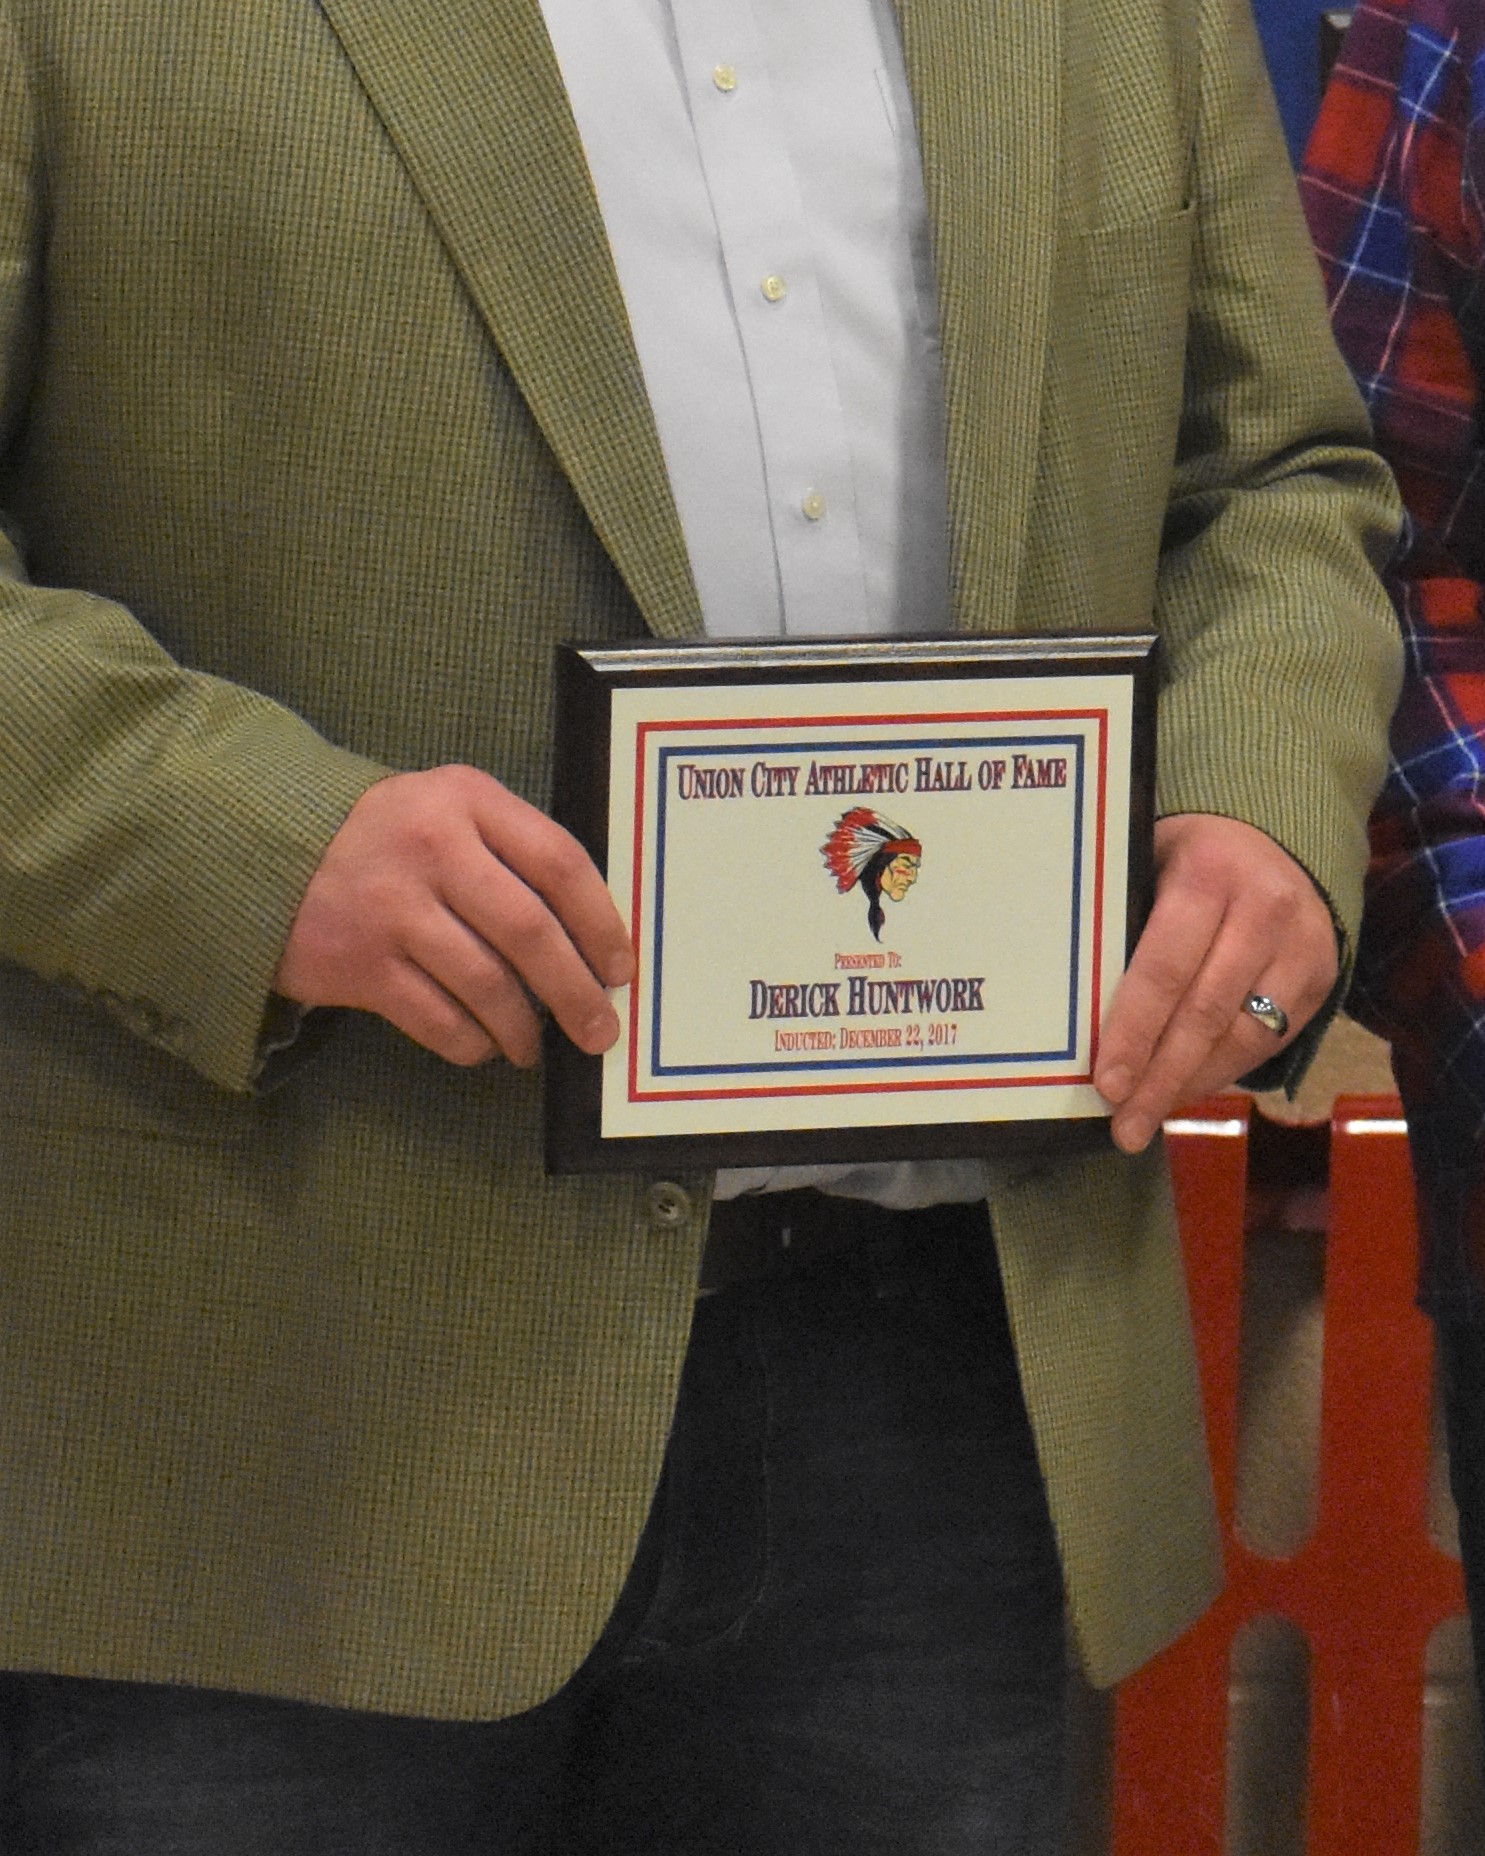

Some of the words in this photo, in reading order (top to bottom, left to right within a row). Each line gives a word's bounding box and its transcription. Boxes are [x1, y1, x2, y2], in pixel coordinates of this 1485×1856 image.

[677, 764, 744, 800] UNION
[751, 761, 801, 798] CITY
[804, 760, 909, 797] ATHLETIC
[914, 757, 972, 792] HALL
[978, 759, 1006, 791] OF
[1011, 754, 1067, 789] FAME
[834, 952, 885, 970] PRESENTED
[748, 979, 840, 1020] DERICK
[846, 976, 985, 1016] HUNTWORK
[774, 1028, 836, 1052] INDUCTED:
[839, 1026, 902, 1050] DECEMBER
[905, 1025, 924, 1051] 22,
[928, 1024, 958, 1046] 2017
